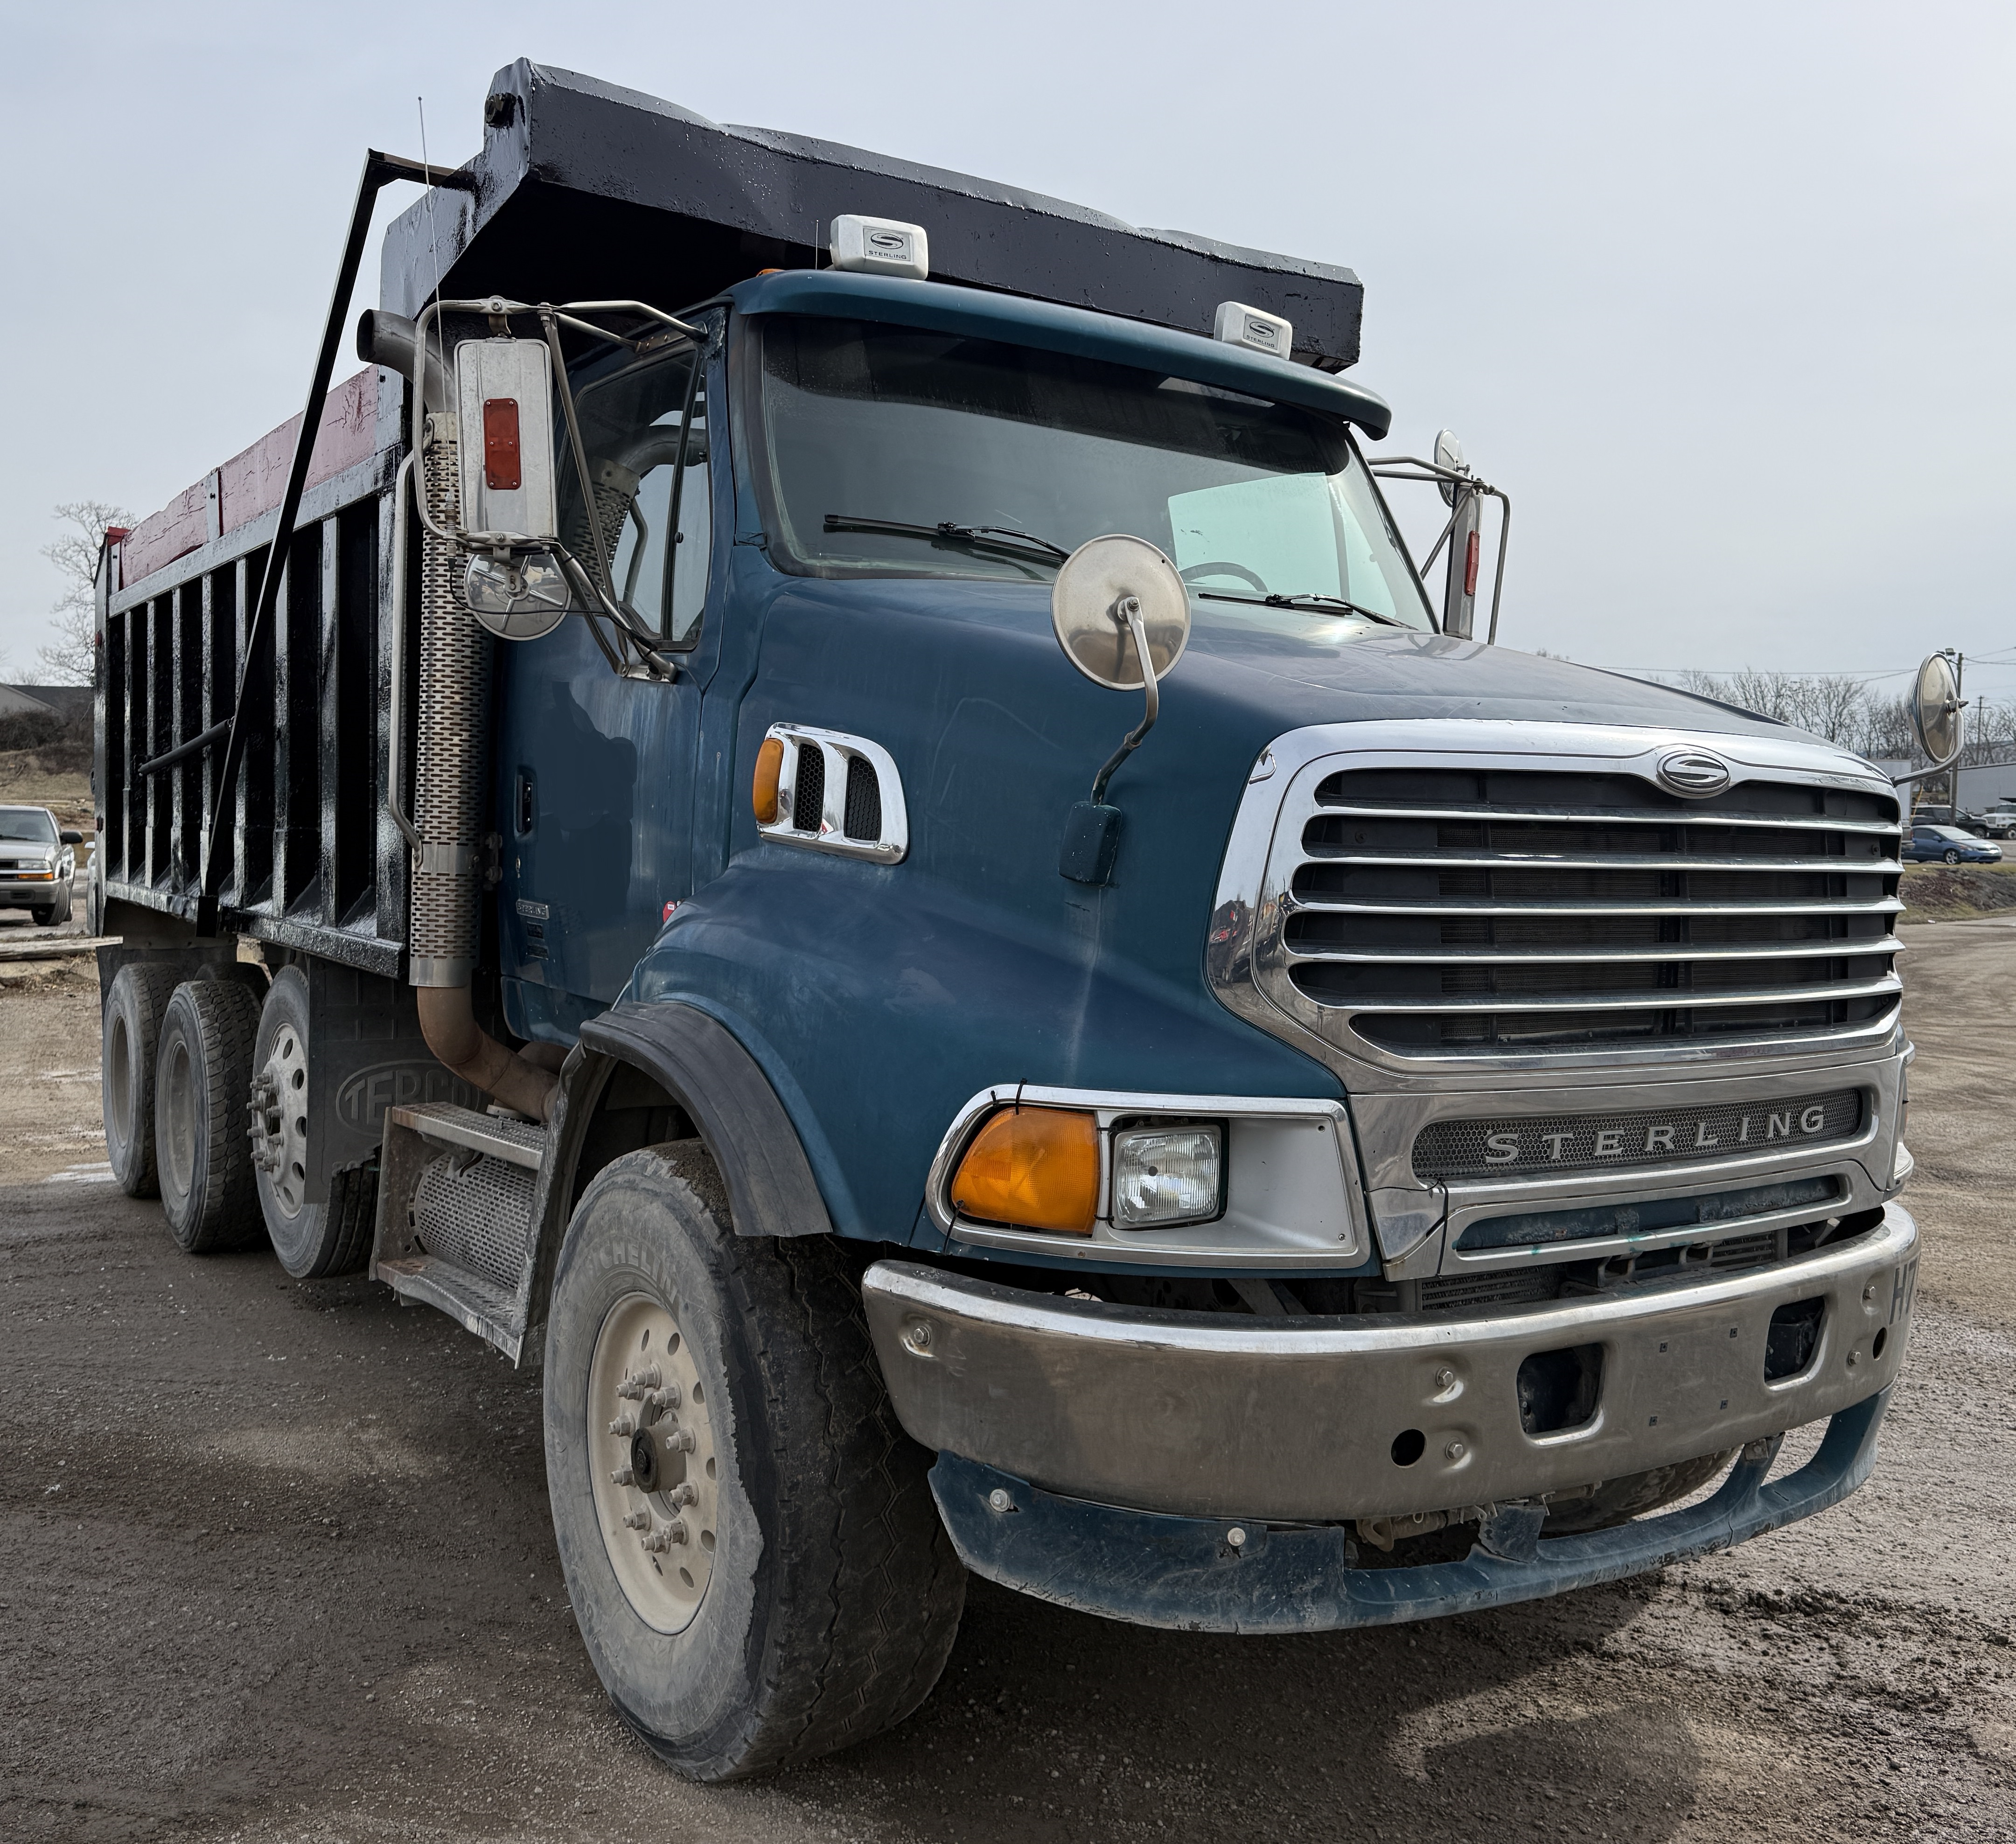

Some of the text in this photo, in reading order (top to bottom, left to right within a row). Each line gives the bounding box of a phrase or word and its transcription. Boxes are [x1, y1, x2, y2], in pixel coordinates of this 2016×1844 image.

[869, 251, 907, 259] STERLING
[1246, 335, 1275, 348] STERLING
[1484, 1106, 1824, 1163] STERLING
[579, 1240, 677, 1304] ICHELIN
